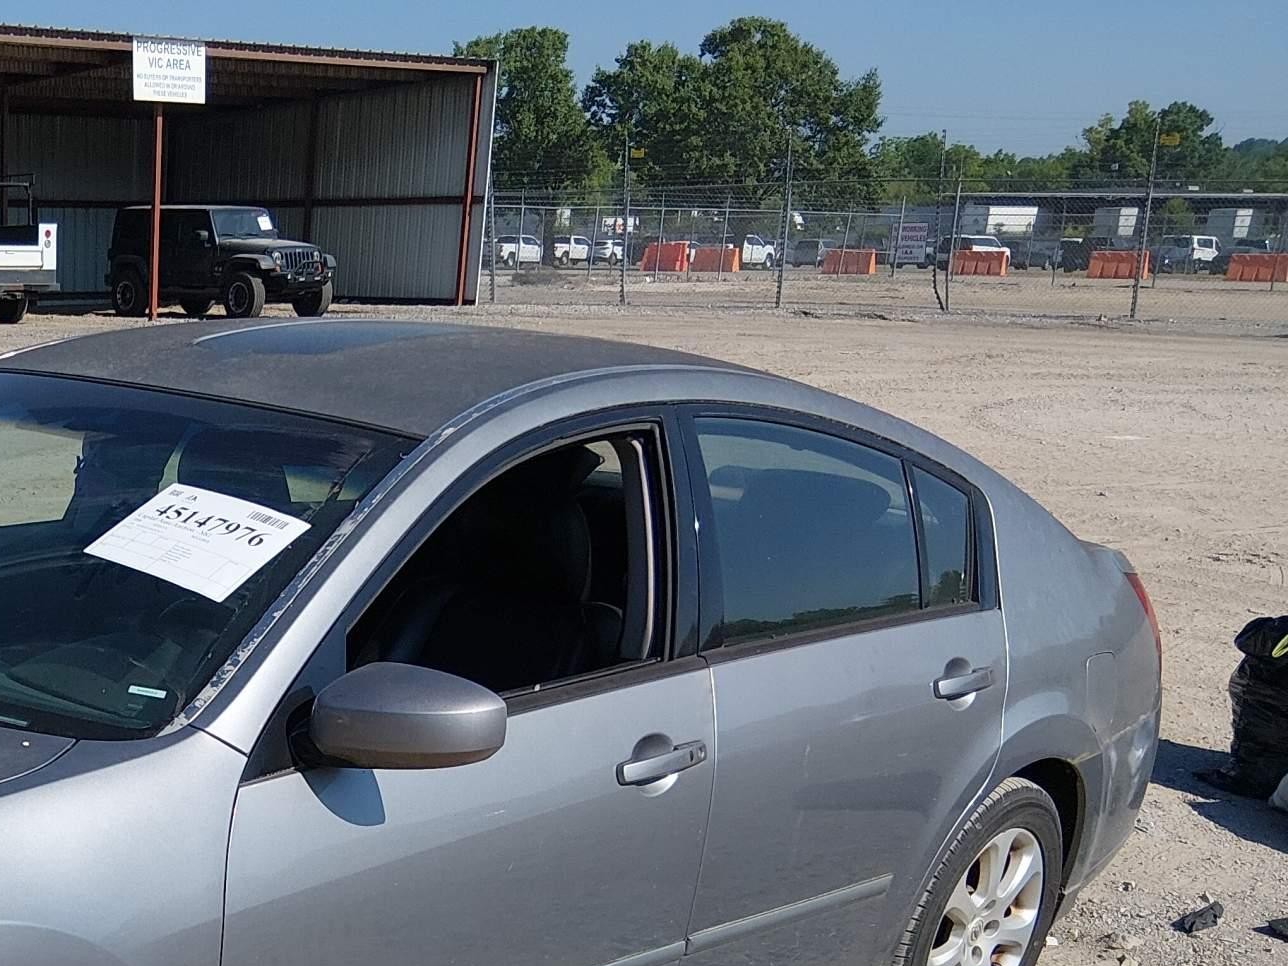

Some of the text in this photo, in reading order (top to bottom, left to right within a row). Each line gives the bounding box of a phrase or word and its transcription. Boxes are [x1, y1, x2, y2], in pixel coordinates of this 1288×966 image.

[136, 41, 202, 56] PROGRESSIVE
[148, 57, 191, 70] VIC AREA
[155, 503, 272, 547] 45147976
